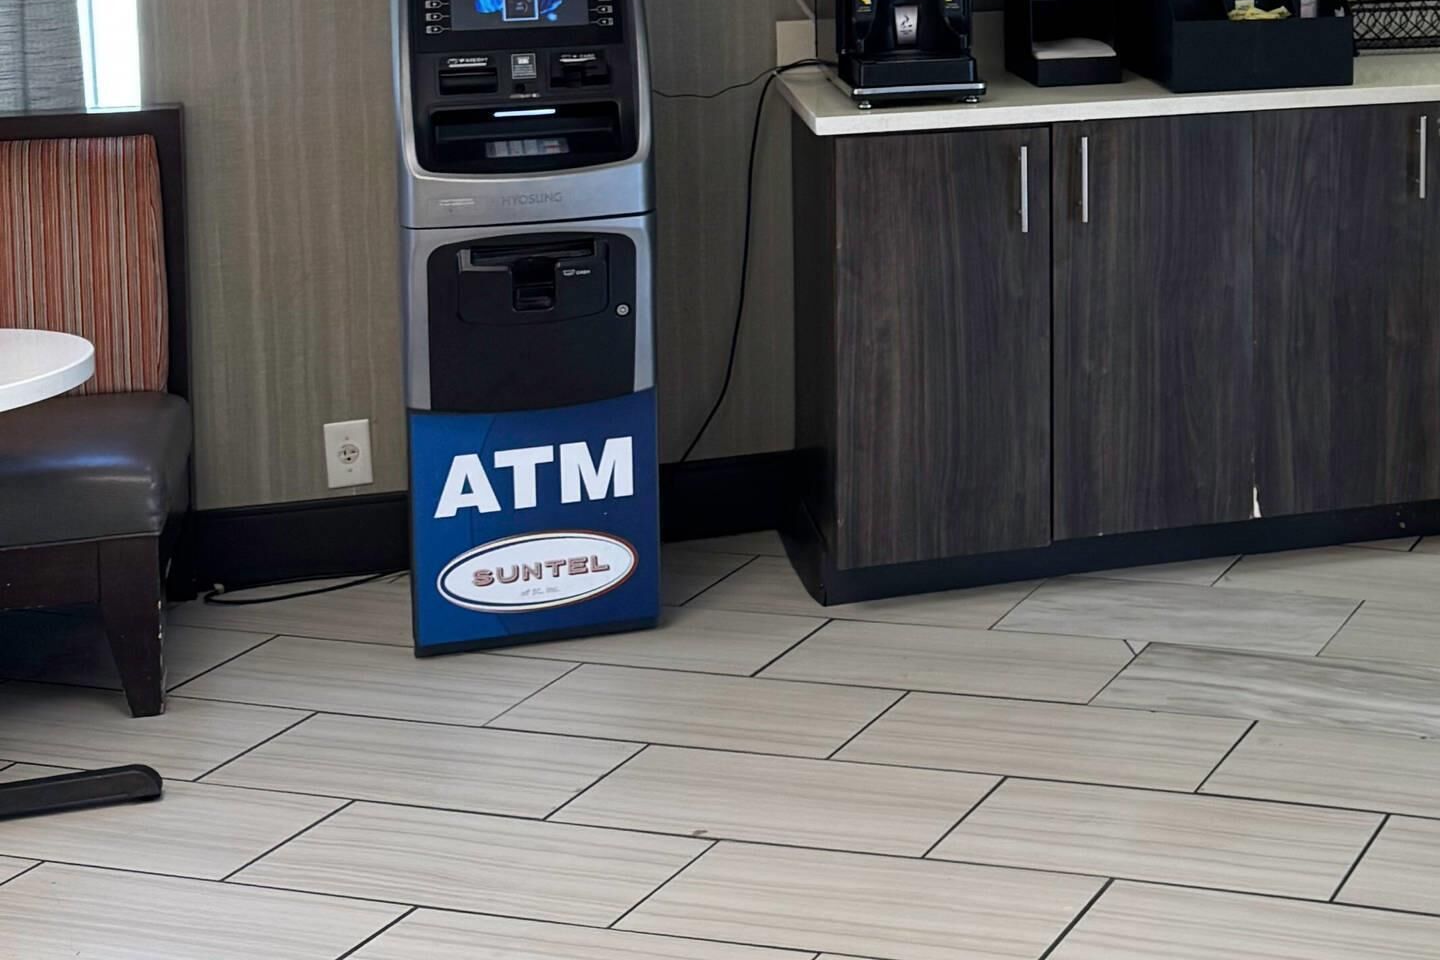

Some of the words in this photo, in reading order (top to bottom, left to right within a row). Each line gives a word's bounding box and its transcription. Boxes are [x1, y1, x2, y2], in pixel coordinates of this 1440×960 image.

[502, 191, 564, 207] HYOSUNG
[434, 436, 634, 519] ATM
[472, 555, 611, 588] SUNTEL
